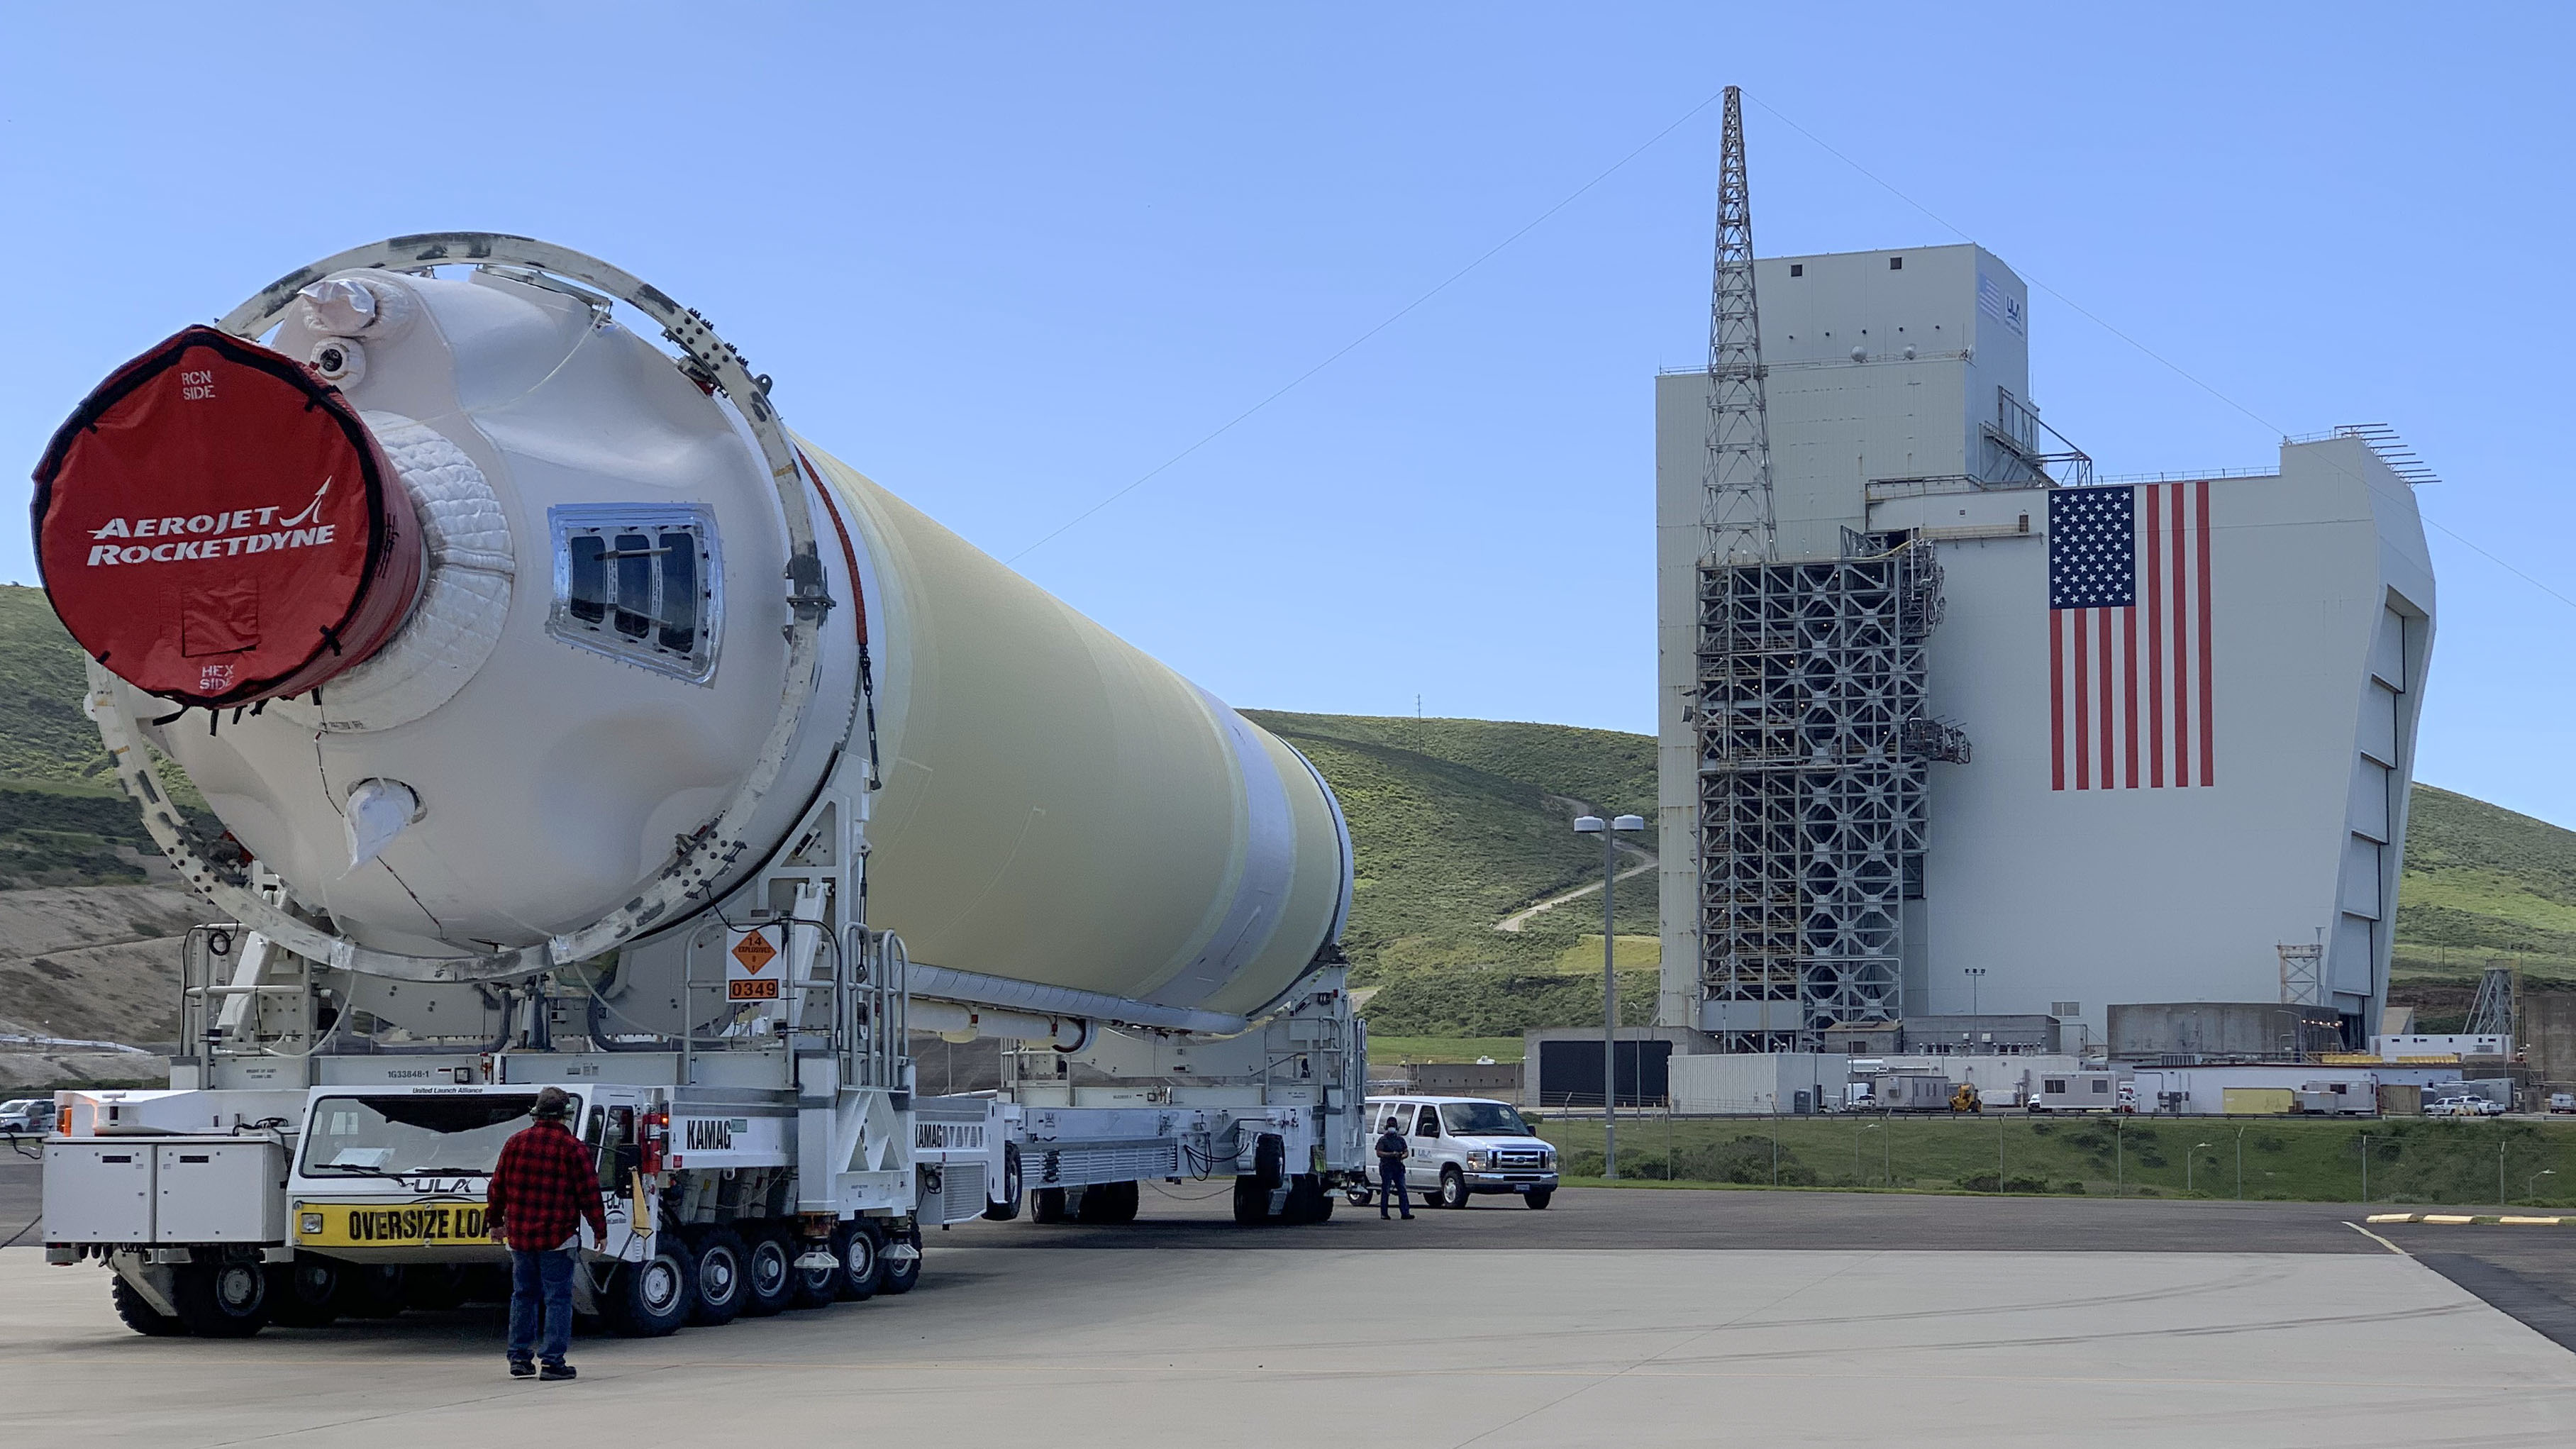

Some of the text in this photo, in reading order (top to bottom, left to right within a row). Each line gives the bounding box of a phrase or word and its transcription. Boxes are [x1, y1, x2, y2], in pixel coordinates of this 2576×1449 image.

[2006, 296, 2021, 321] ULA
[181, 370, 212, 385] RCN
[182, 384, 216, 400] SIDE
[87, 506, 280, 539] AEROJET
[87, 524, 335, 566] ROCKETDYNE
[201, 664, 234, 677] HEX
[199, 675, 235, 690] SIDE
[732, 982, 776, 996] 0349
[687, 1120, 731, 1150] KAMAG
[413, 1177, 474, 1193] ULA
[349, 1208, 492, 1240] OVERSIZE LOA
